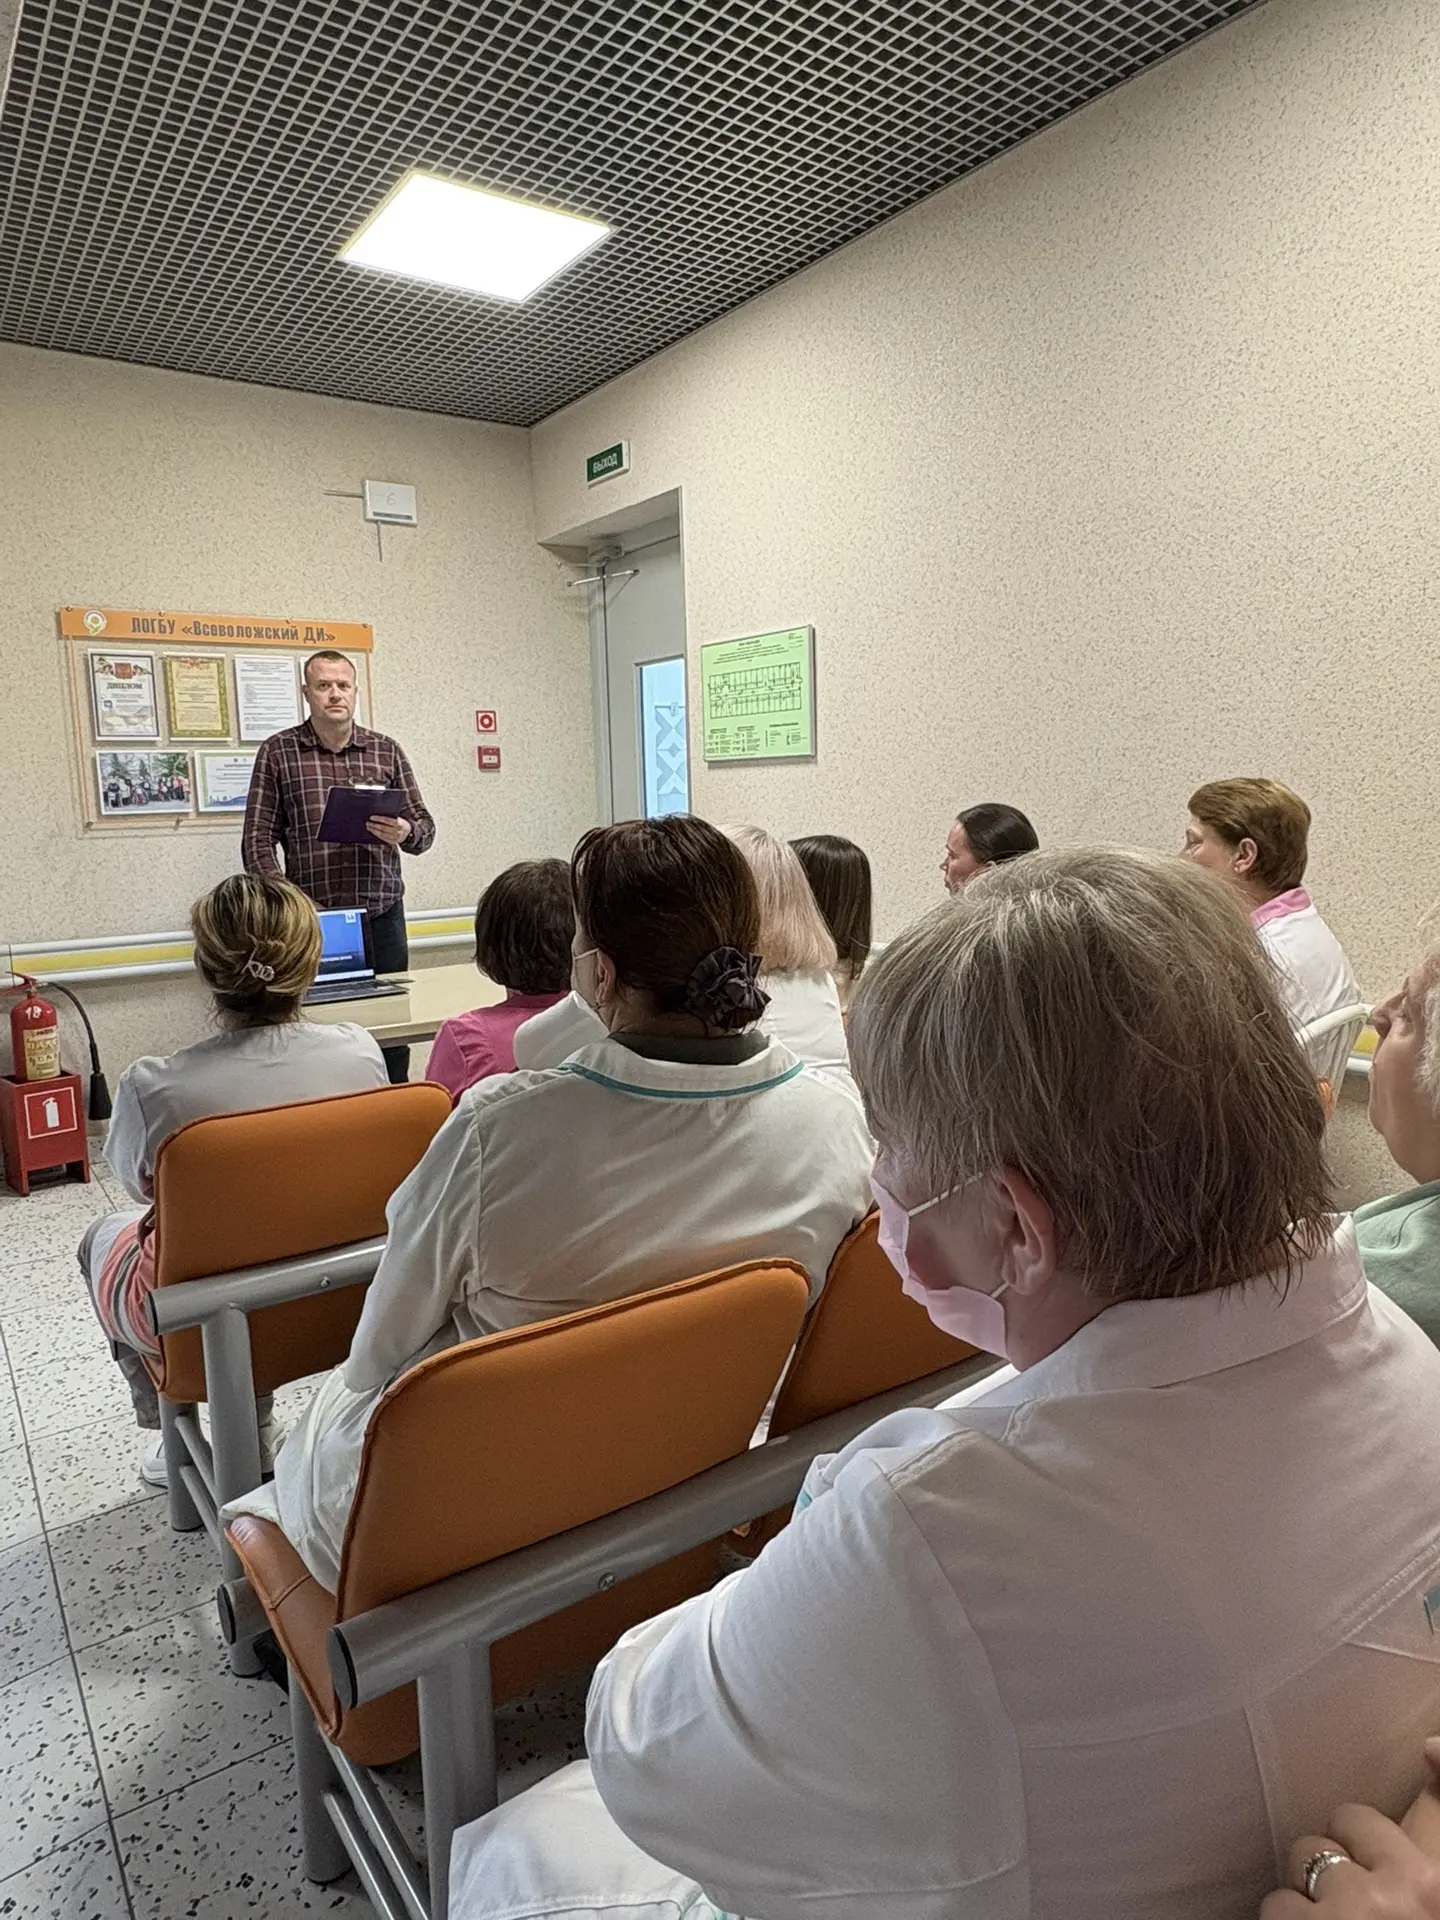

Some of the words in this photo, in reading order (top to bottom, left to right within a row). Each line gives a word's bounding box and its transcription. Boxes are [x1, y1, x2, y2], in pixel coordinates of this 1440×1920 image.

[592, 452, 617, 473] ВЫХОД
[131, 617, 175, 634] ЛОГБУ
[181, 620, 299, 641] «Всеволожский
[303, 626, 336, 644] ДИ»
[25, 1005, 42, 1020] 18
